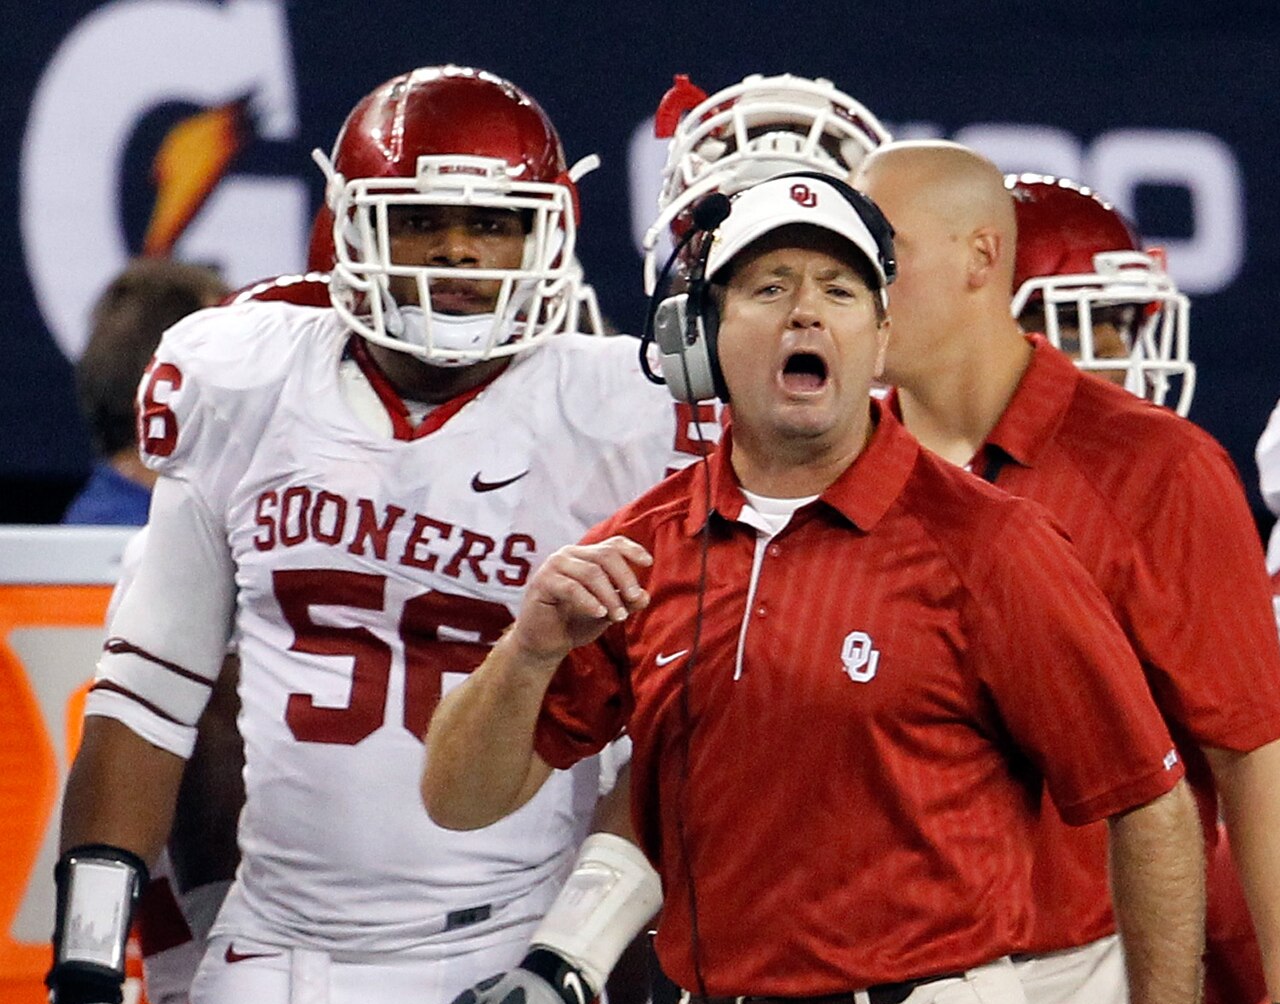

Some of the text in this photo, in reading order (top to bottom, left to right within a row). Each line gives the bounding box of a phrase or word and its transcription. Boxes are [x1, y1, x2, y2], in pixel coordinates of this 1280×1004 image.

[790, 184, 817, 208] OU
[253, 490, 537, 588] SOONERS
[272, 568, 517, 746] 56
[841, 630, 882, 683] OU
